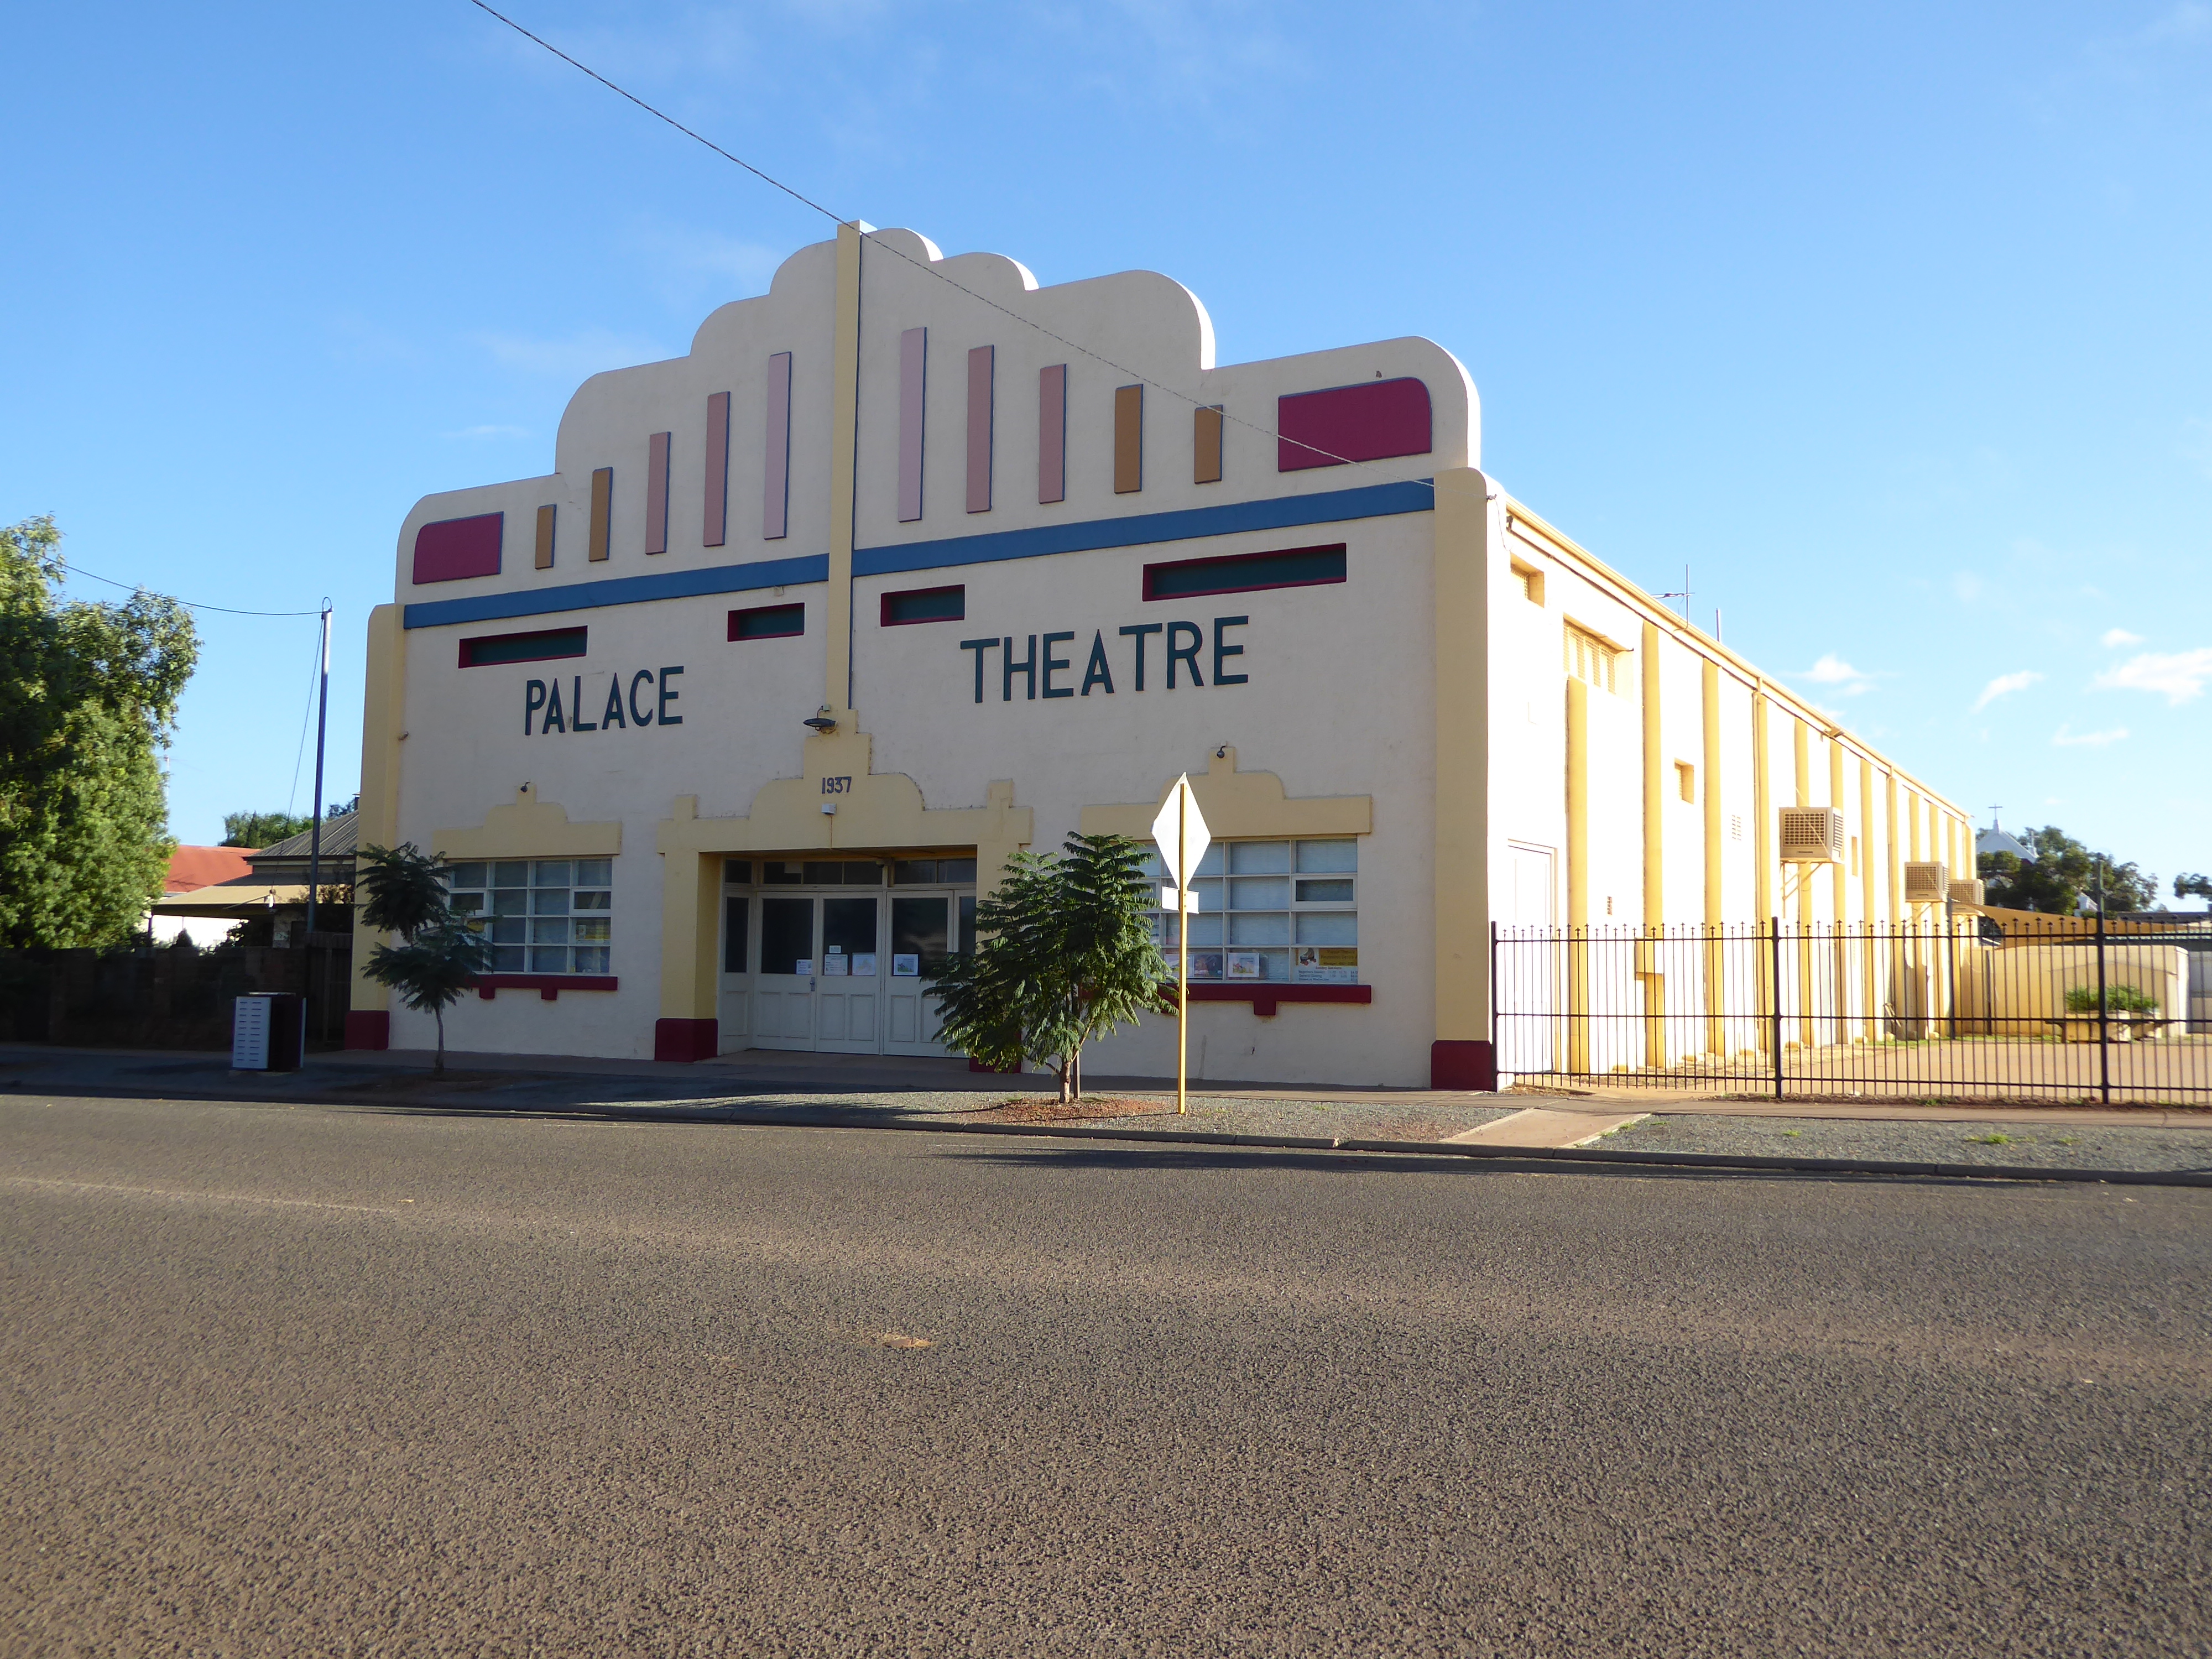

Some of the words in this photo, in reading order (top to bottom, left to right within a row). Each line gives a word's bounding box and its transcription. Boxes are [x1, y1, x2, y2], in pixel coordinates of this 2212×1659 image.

[525, 666, 684, 735] PALACE
[960, 615, 1249, 703] THEATRE
[822, 776, 852, 794] 1937
